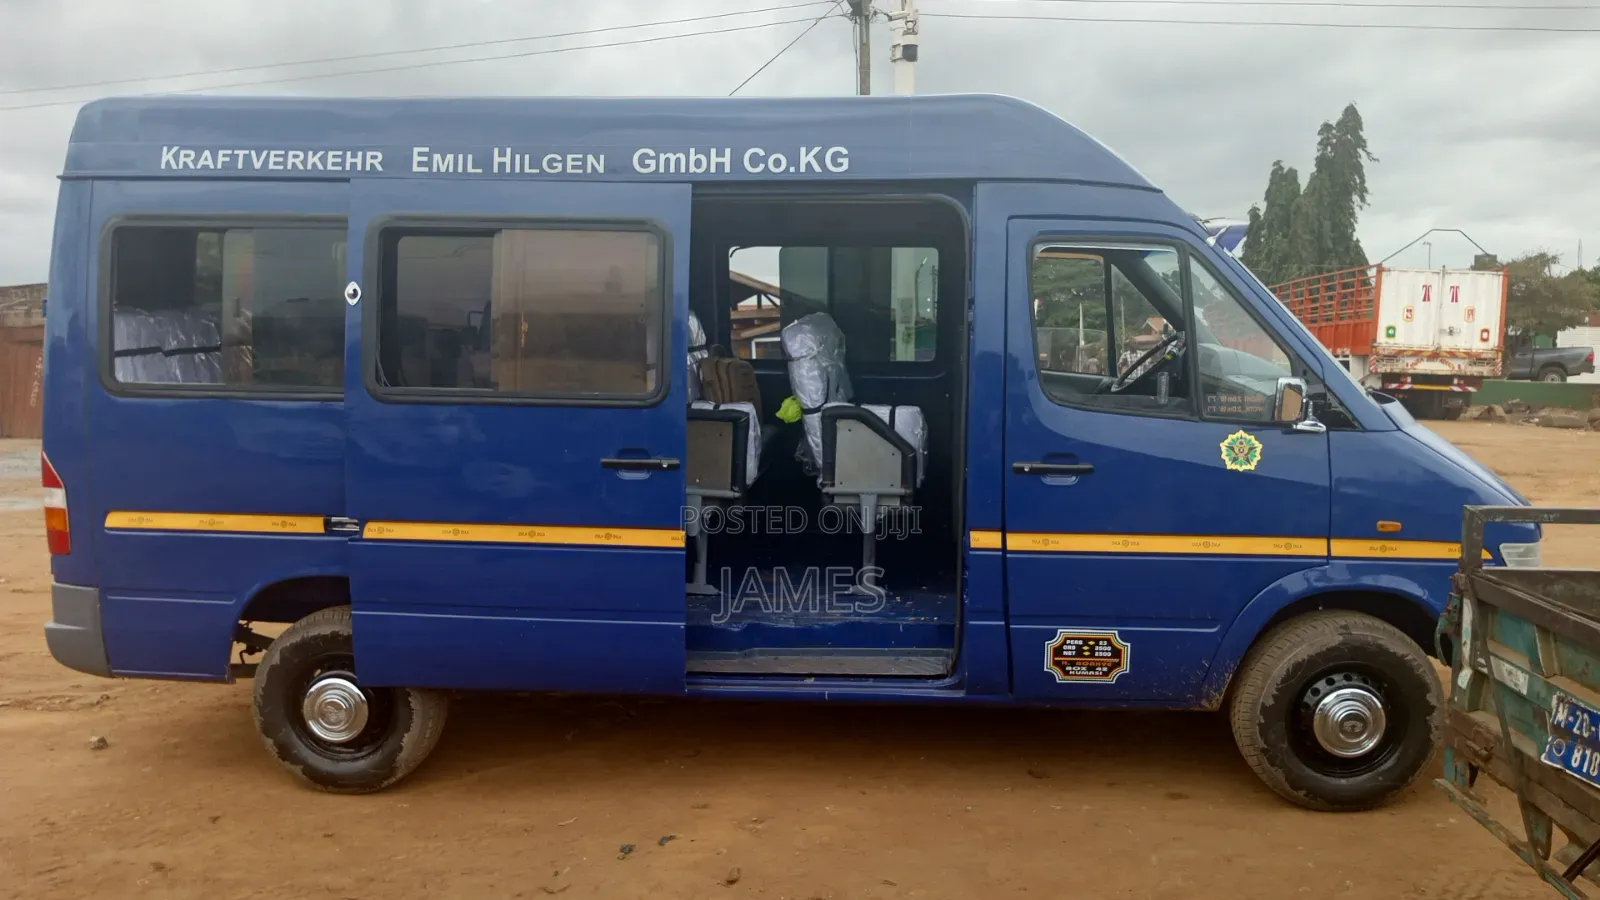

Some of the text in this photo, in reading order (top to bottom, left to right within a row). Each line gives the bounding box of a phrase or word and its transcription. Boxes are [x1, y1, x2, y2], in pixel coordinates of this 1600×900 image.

[161, 146, 850, 173] KRAFTVERKEHR EMIL HILGEN GmbH Co.KG
